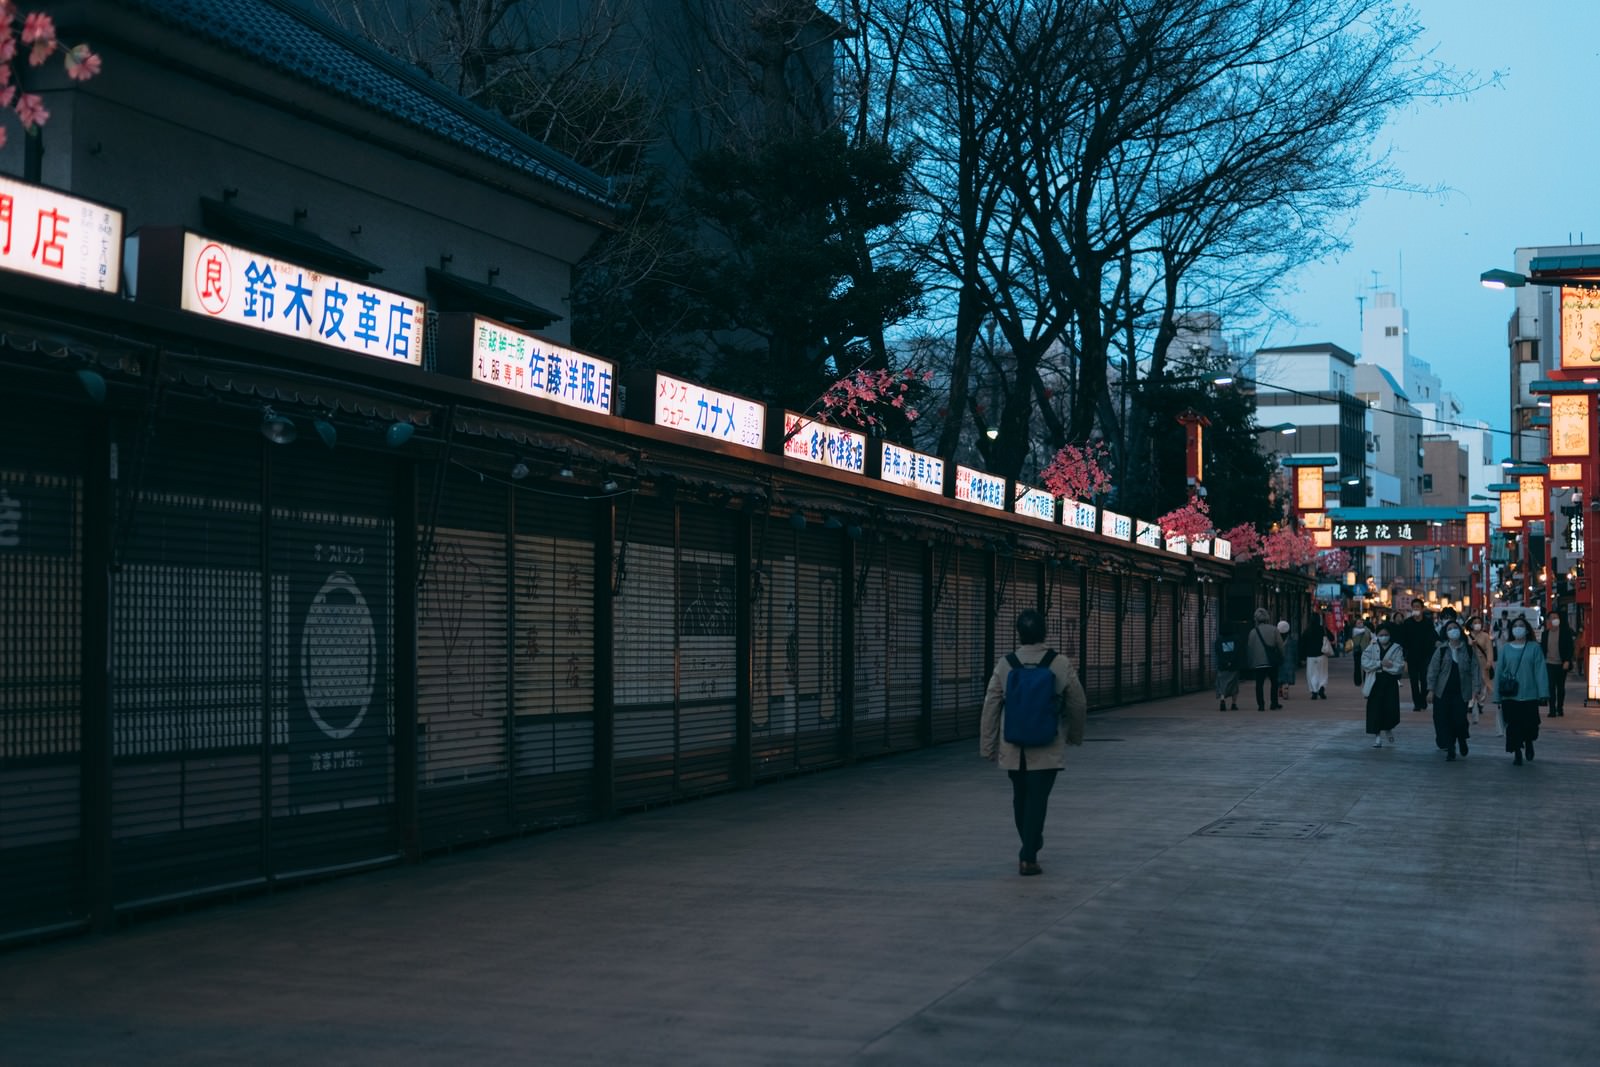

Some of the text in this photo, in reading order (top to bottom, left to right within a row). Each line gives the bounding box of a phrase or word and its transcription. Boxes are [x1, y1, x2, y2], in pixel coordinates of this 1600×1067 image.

[202, 254, 224, 302] 良
[243, 260, 414, 360] 鈴木皮革店
[478, 355, 525, 389] 礼服専門
[528, 347, 612, 411] 佐藤洋服店
[695, 392, 736, 437] カナメ
[1333, 523, 1413, 540] 伝法院通
